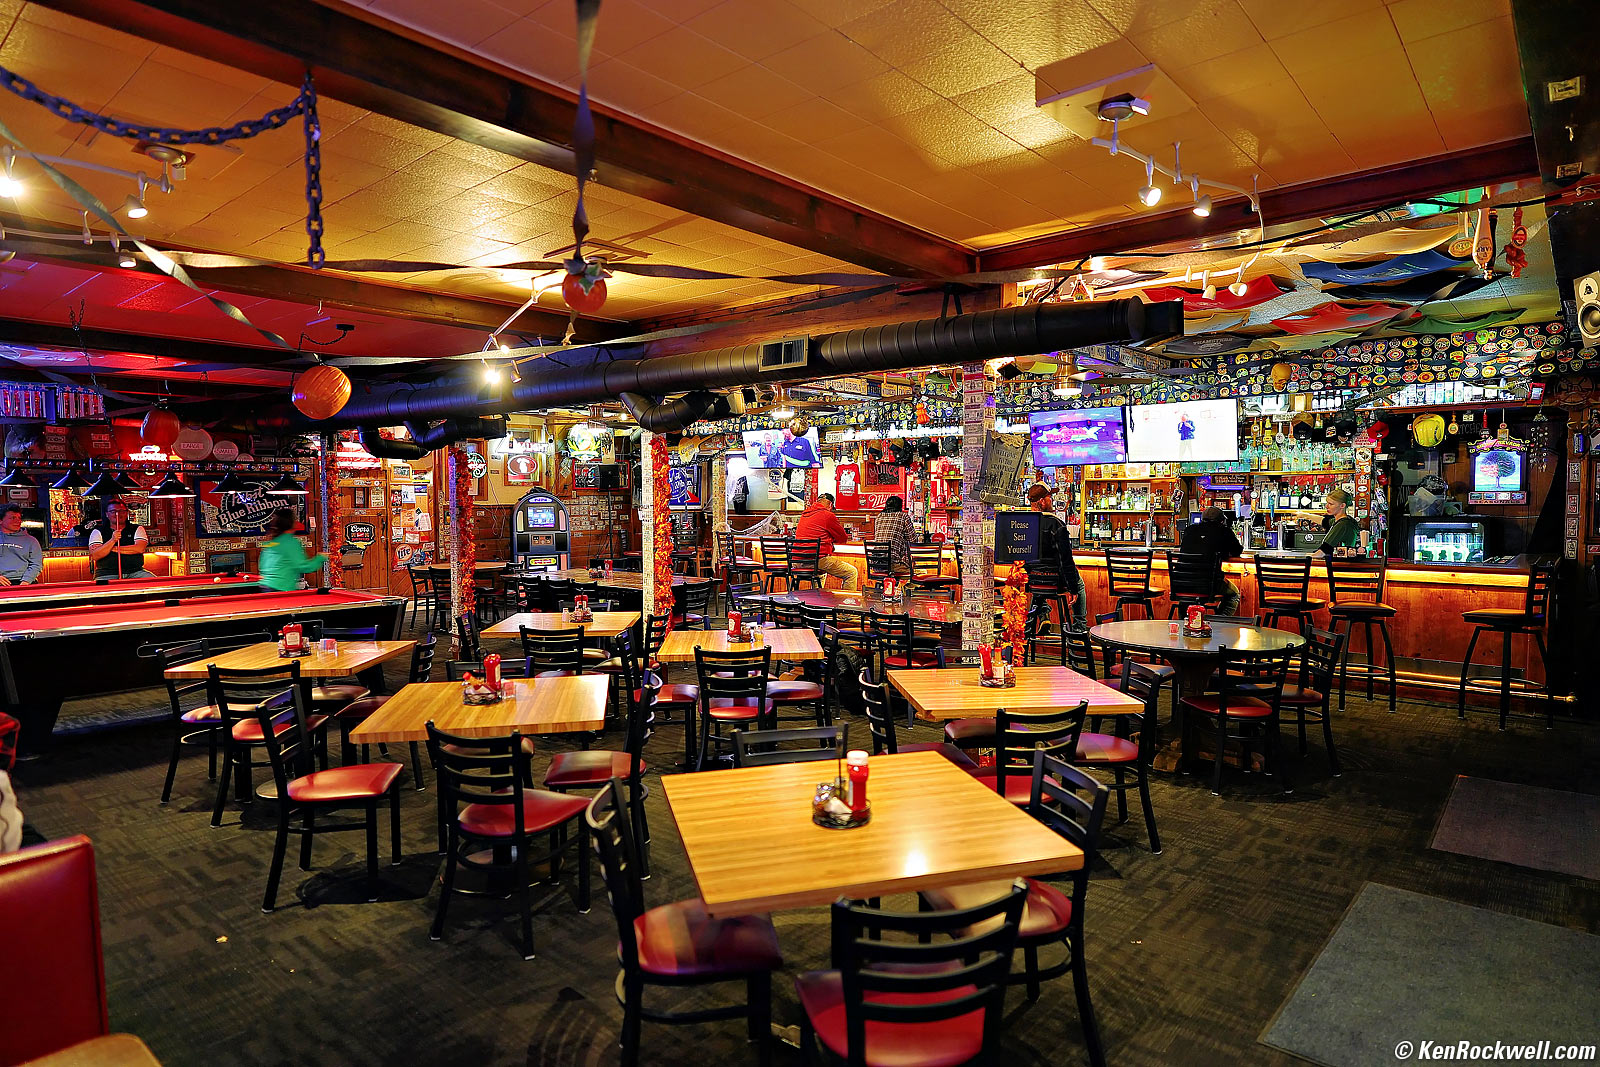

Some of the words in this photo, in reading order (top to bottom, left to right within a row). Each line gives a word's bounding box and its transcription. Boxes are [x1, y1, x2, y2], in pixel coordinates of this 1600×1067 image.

[219, 507, 246, 527] Blue
[245, 498, 289, 515] Ribbon
[350, 524, 370, 533] Coors
[1010, 520, 1030, 529] Please
[1013, 532, 1026, 541] Seat
[1007, 544, 1033, 554] Yourself
